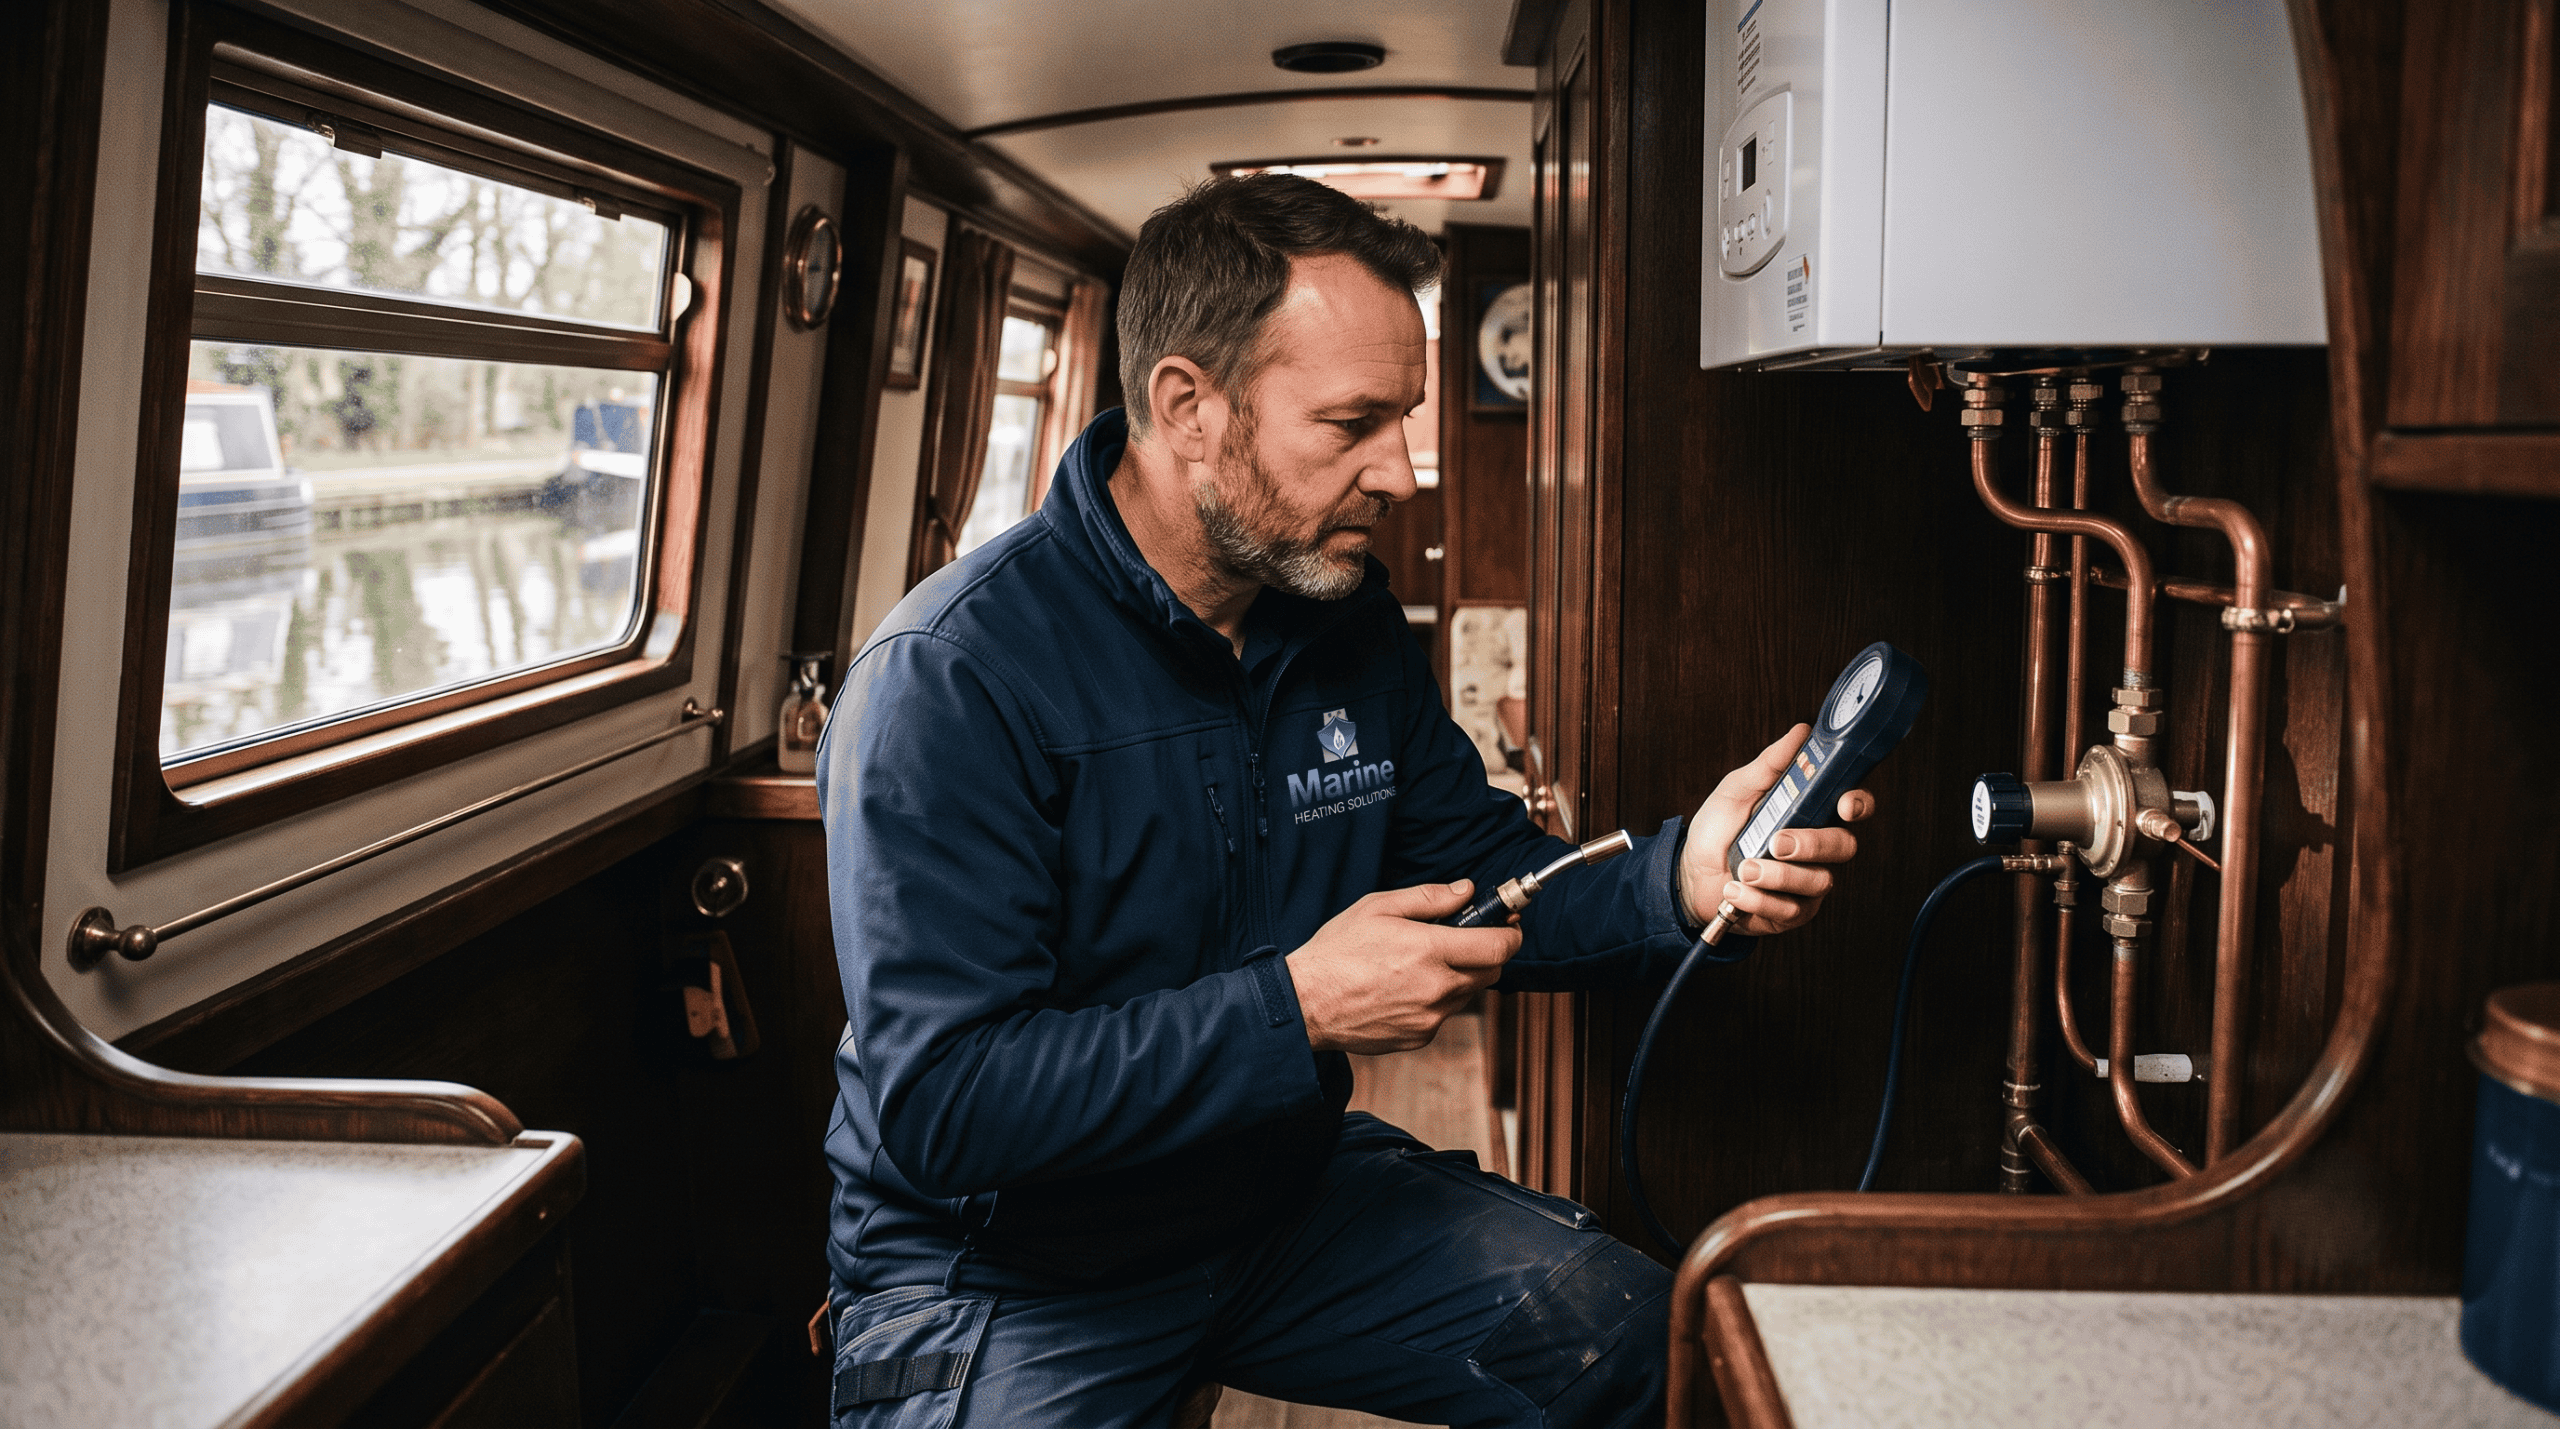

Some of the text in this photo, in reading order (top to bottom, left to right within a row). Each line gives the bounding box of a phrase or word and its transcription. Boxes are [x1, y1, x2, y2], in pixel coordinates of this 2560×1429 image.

[1287, 759, 1394, 807] Marine
[1294, 786, 1397, 825] HEATING SOLUTIONS
